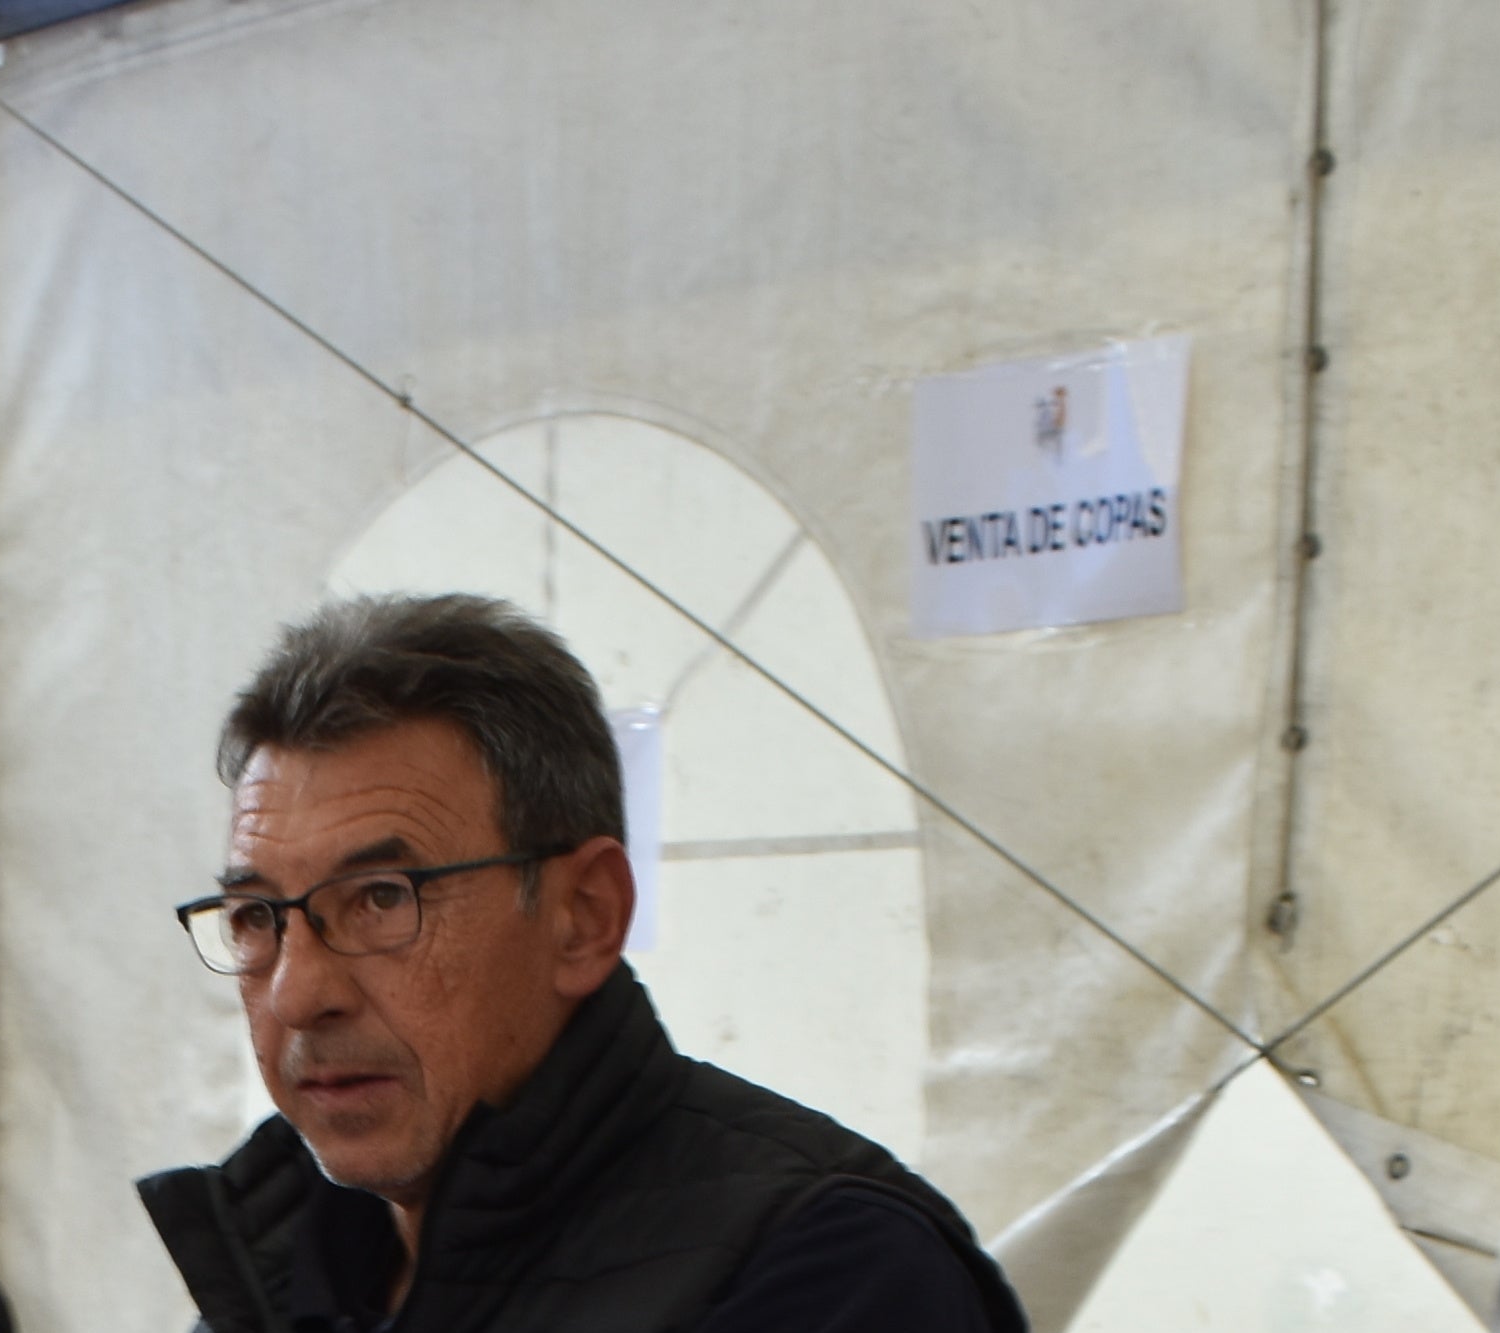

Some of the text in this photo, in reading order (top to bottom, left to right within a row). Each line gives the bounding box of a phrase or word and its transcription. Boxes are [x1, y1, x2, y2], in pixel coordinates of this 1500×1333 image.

[921, 488, 1167, 566] VENTA DE COPAS
